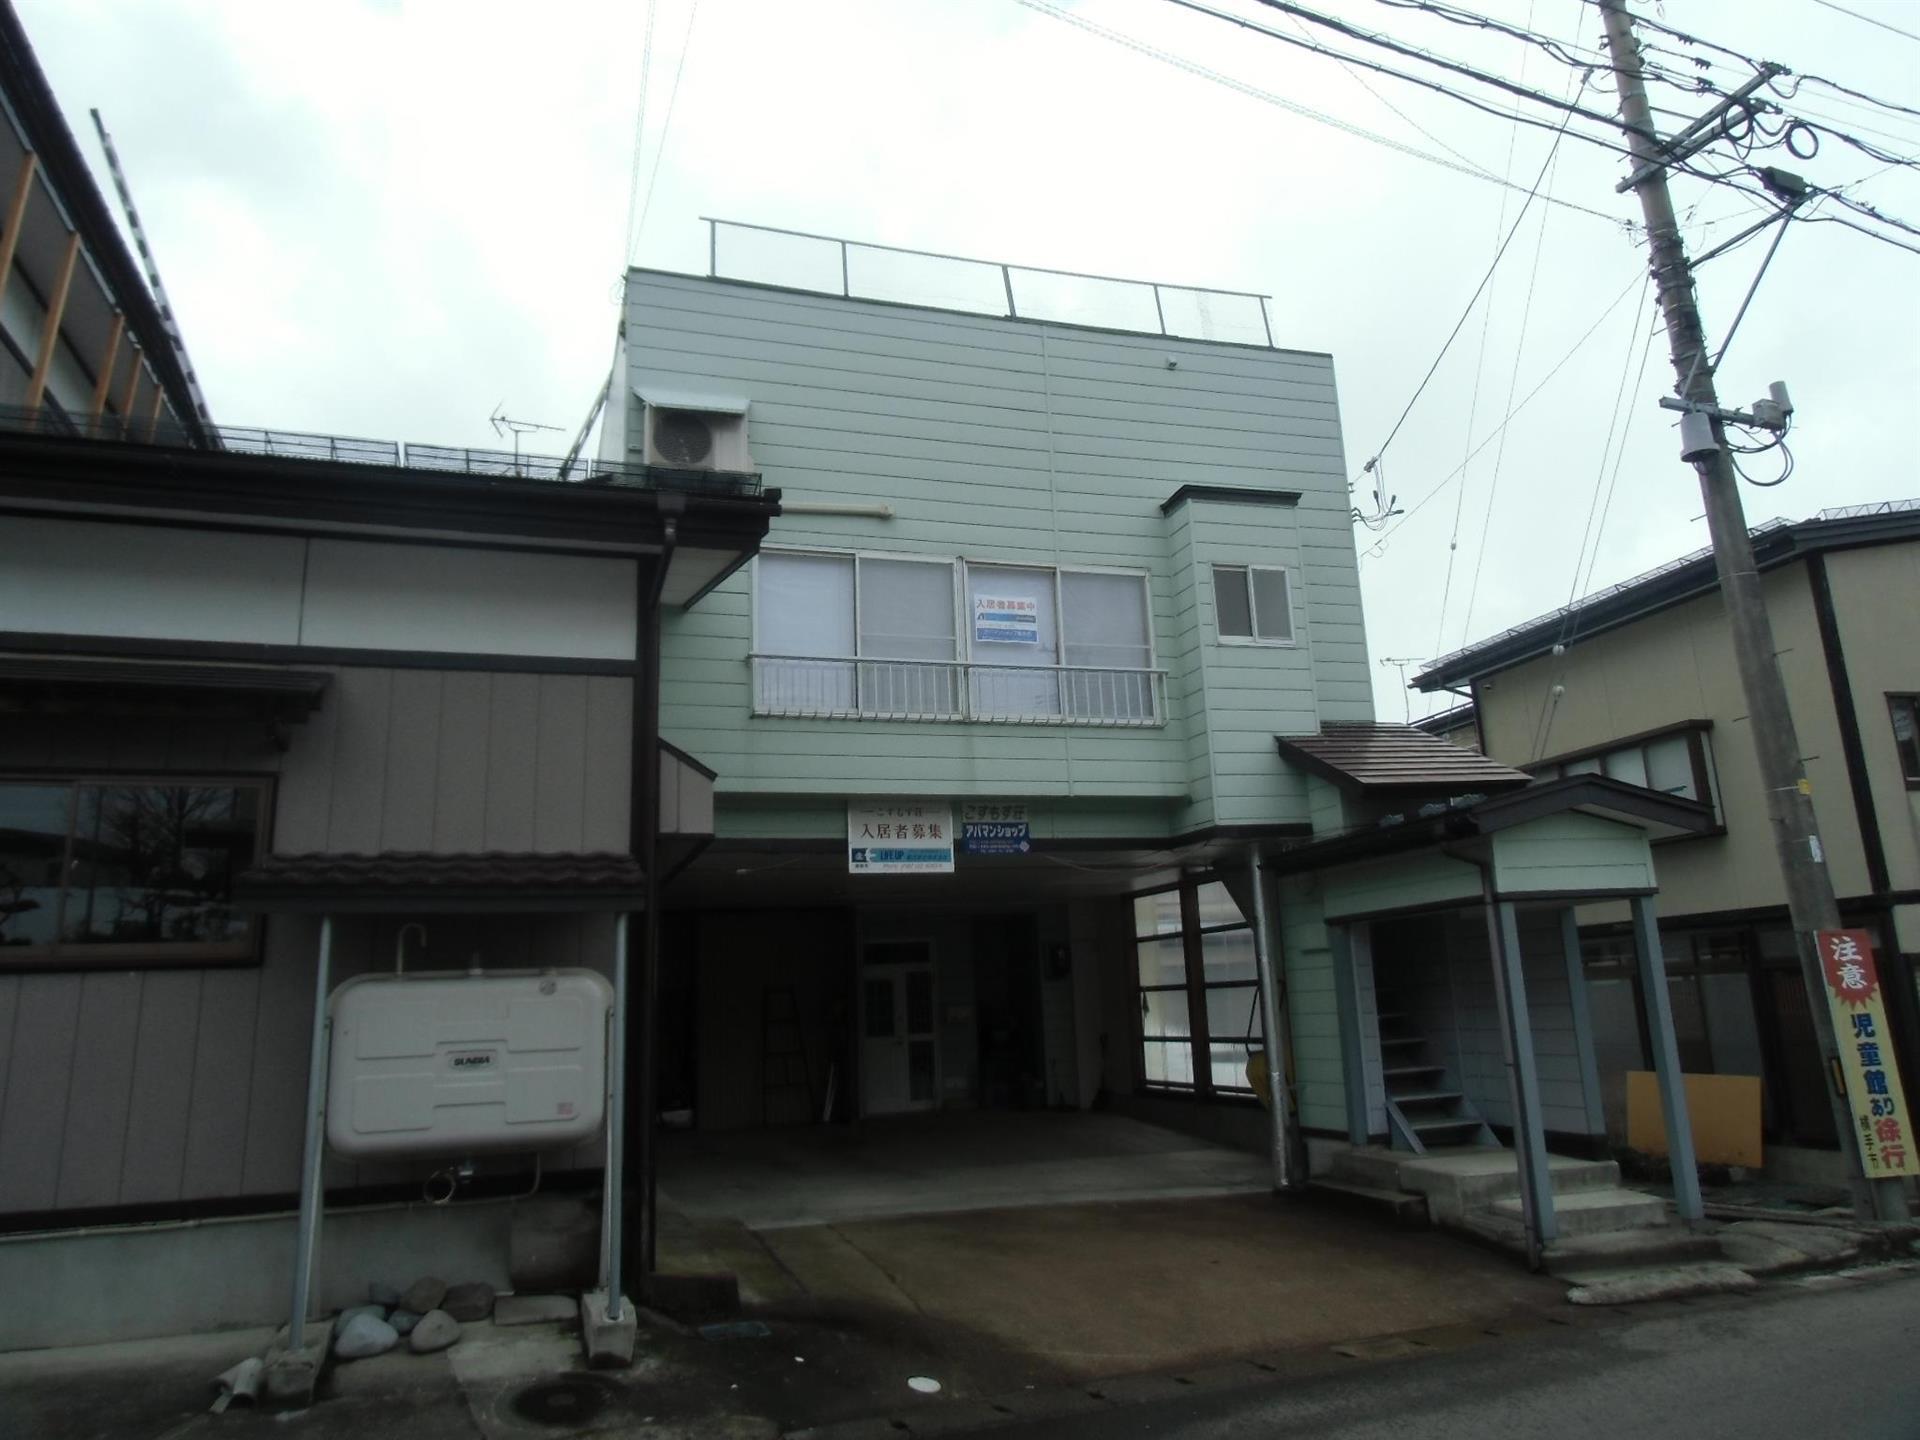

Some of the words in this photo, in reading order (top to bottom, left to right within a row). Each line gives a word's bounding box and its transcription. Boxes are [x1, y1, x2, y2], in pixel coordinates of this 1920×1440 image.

[861, 823, 943, 840] 入居者募集
[1829, 936, 1868, 989] 注意
